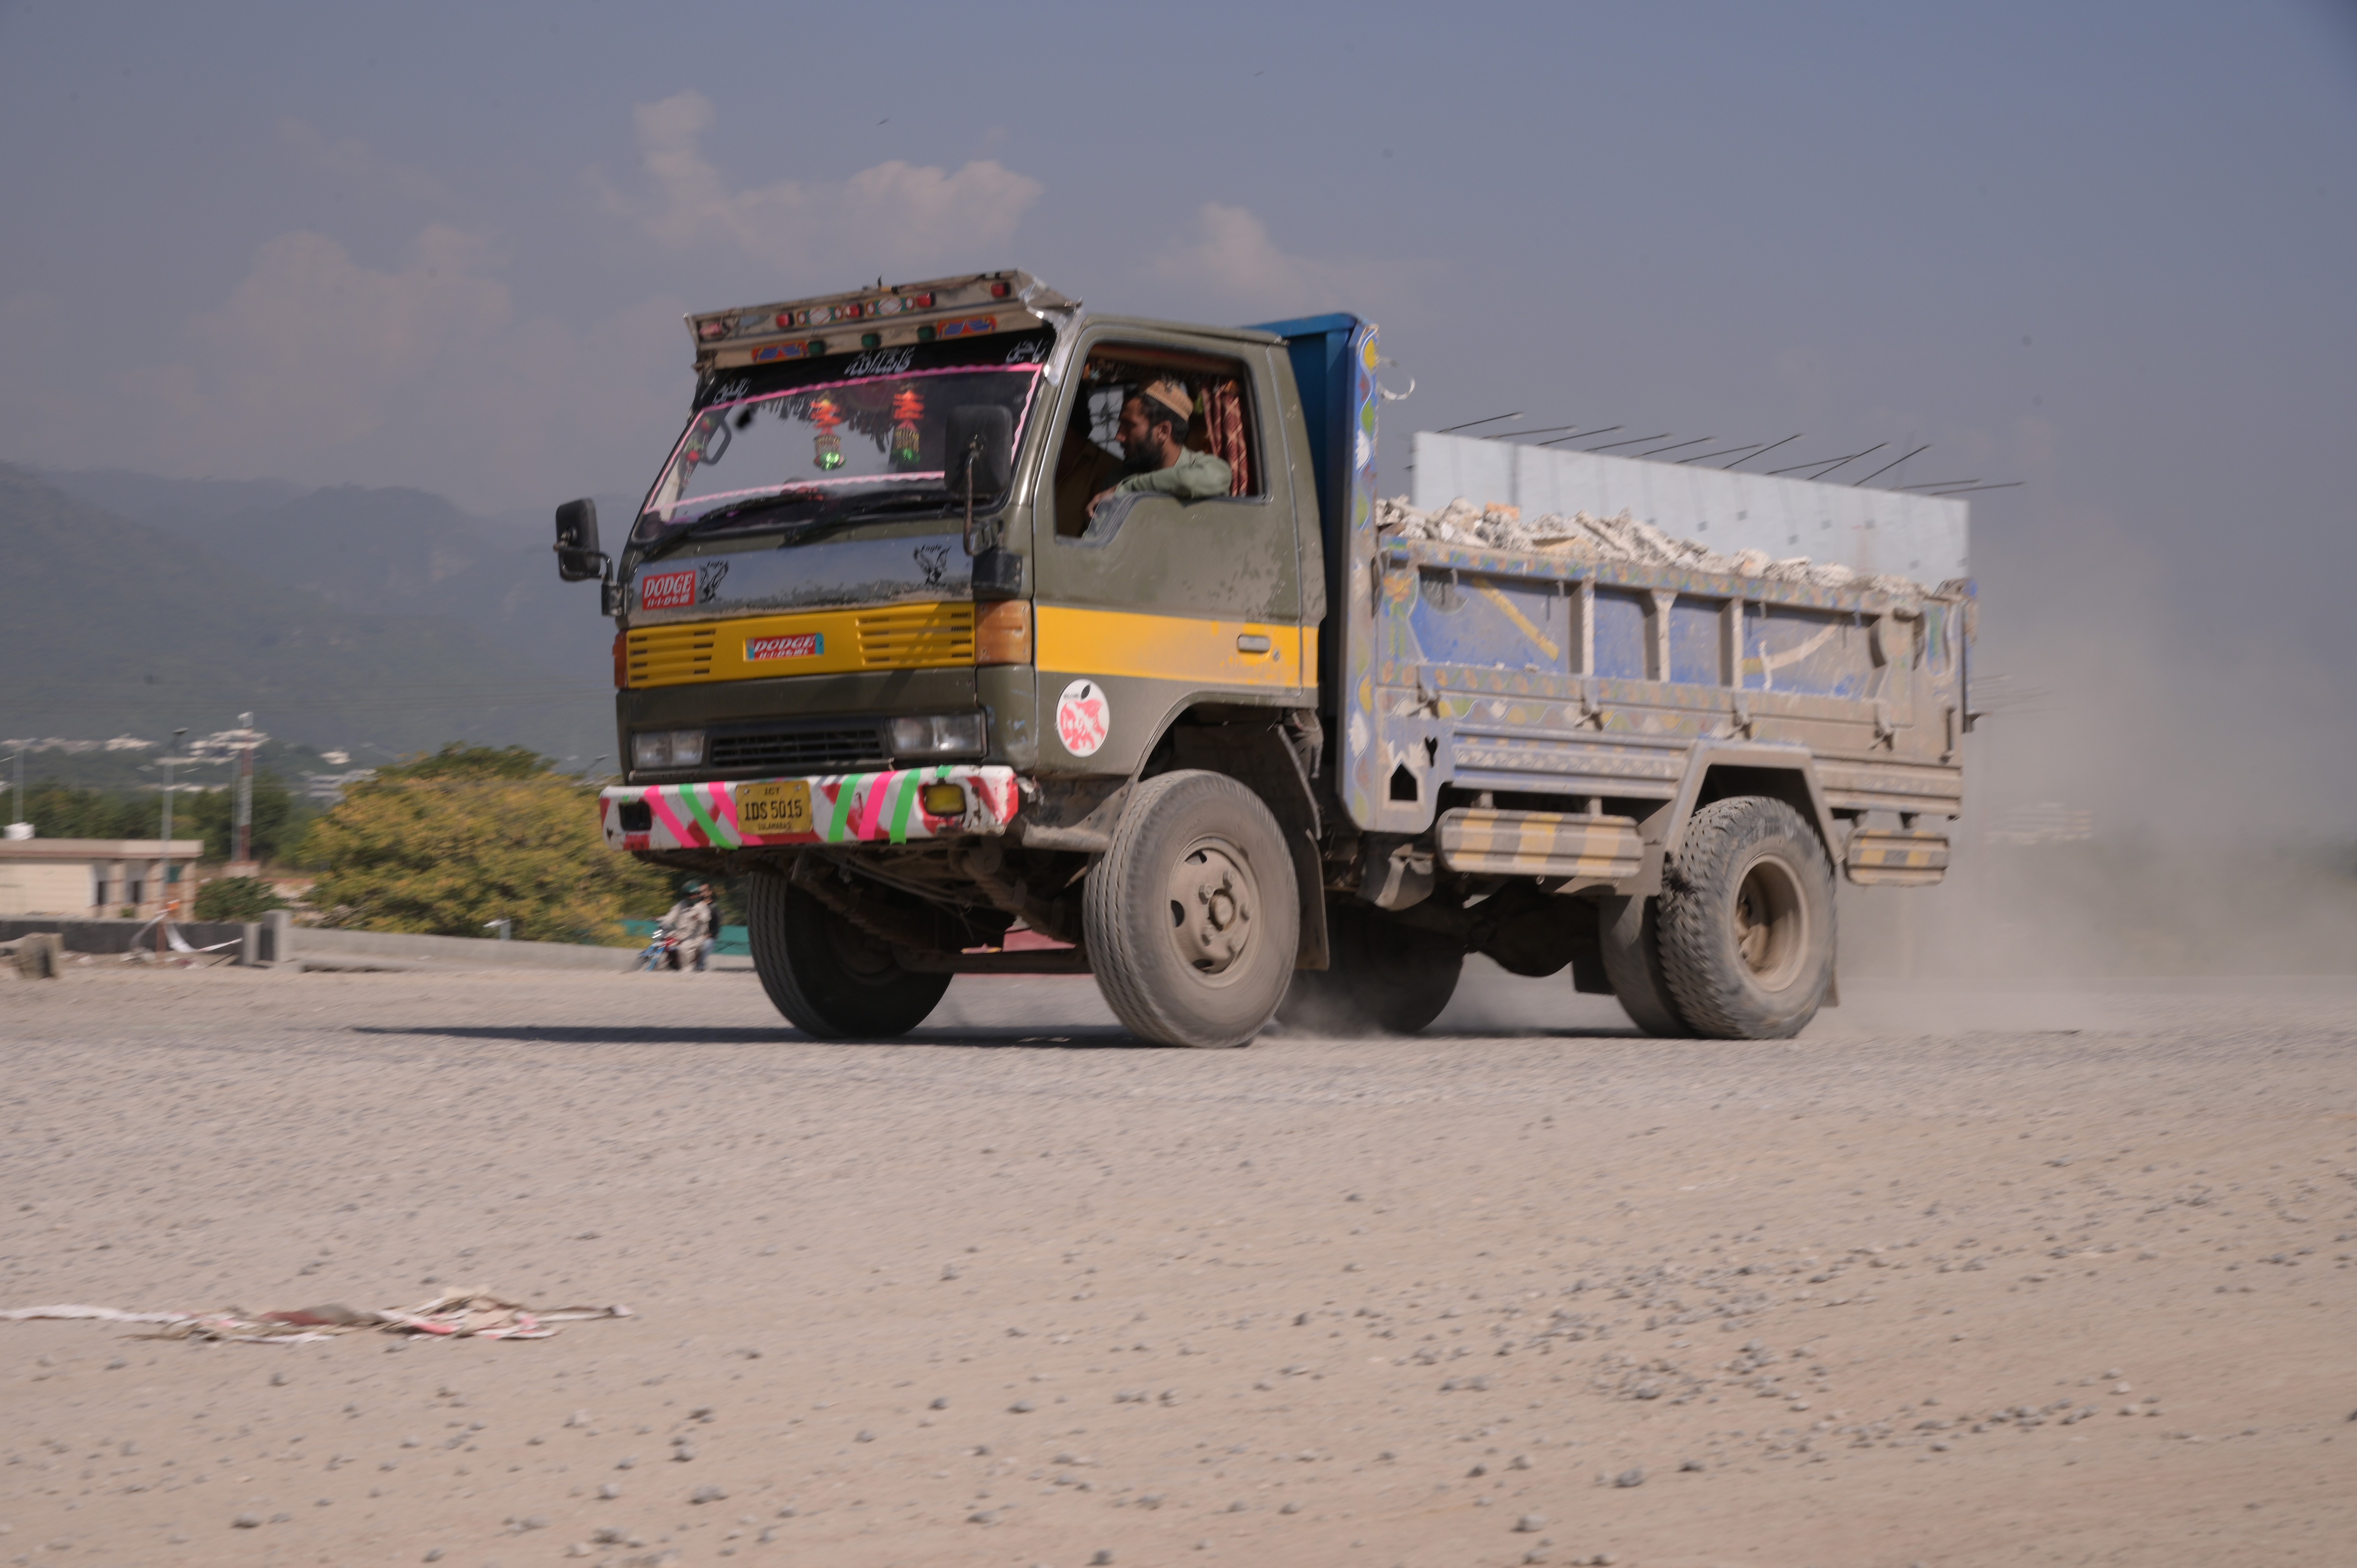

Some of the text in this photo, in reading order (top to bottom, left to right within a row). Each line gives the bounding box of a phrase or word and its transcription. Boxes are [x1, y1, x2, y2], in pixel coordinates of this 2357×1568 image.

[644, 572, 693, 599] DODGE
[754, 634, 816, 653] DODGE
[745, 799, 802, 820] IDS 5015
